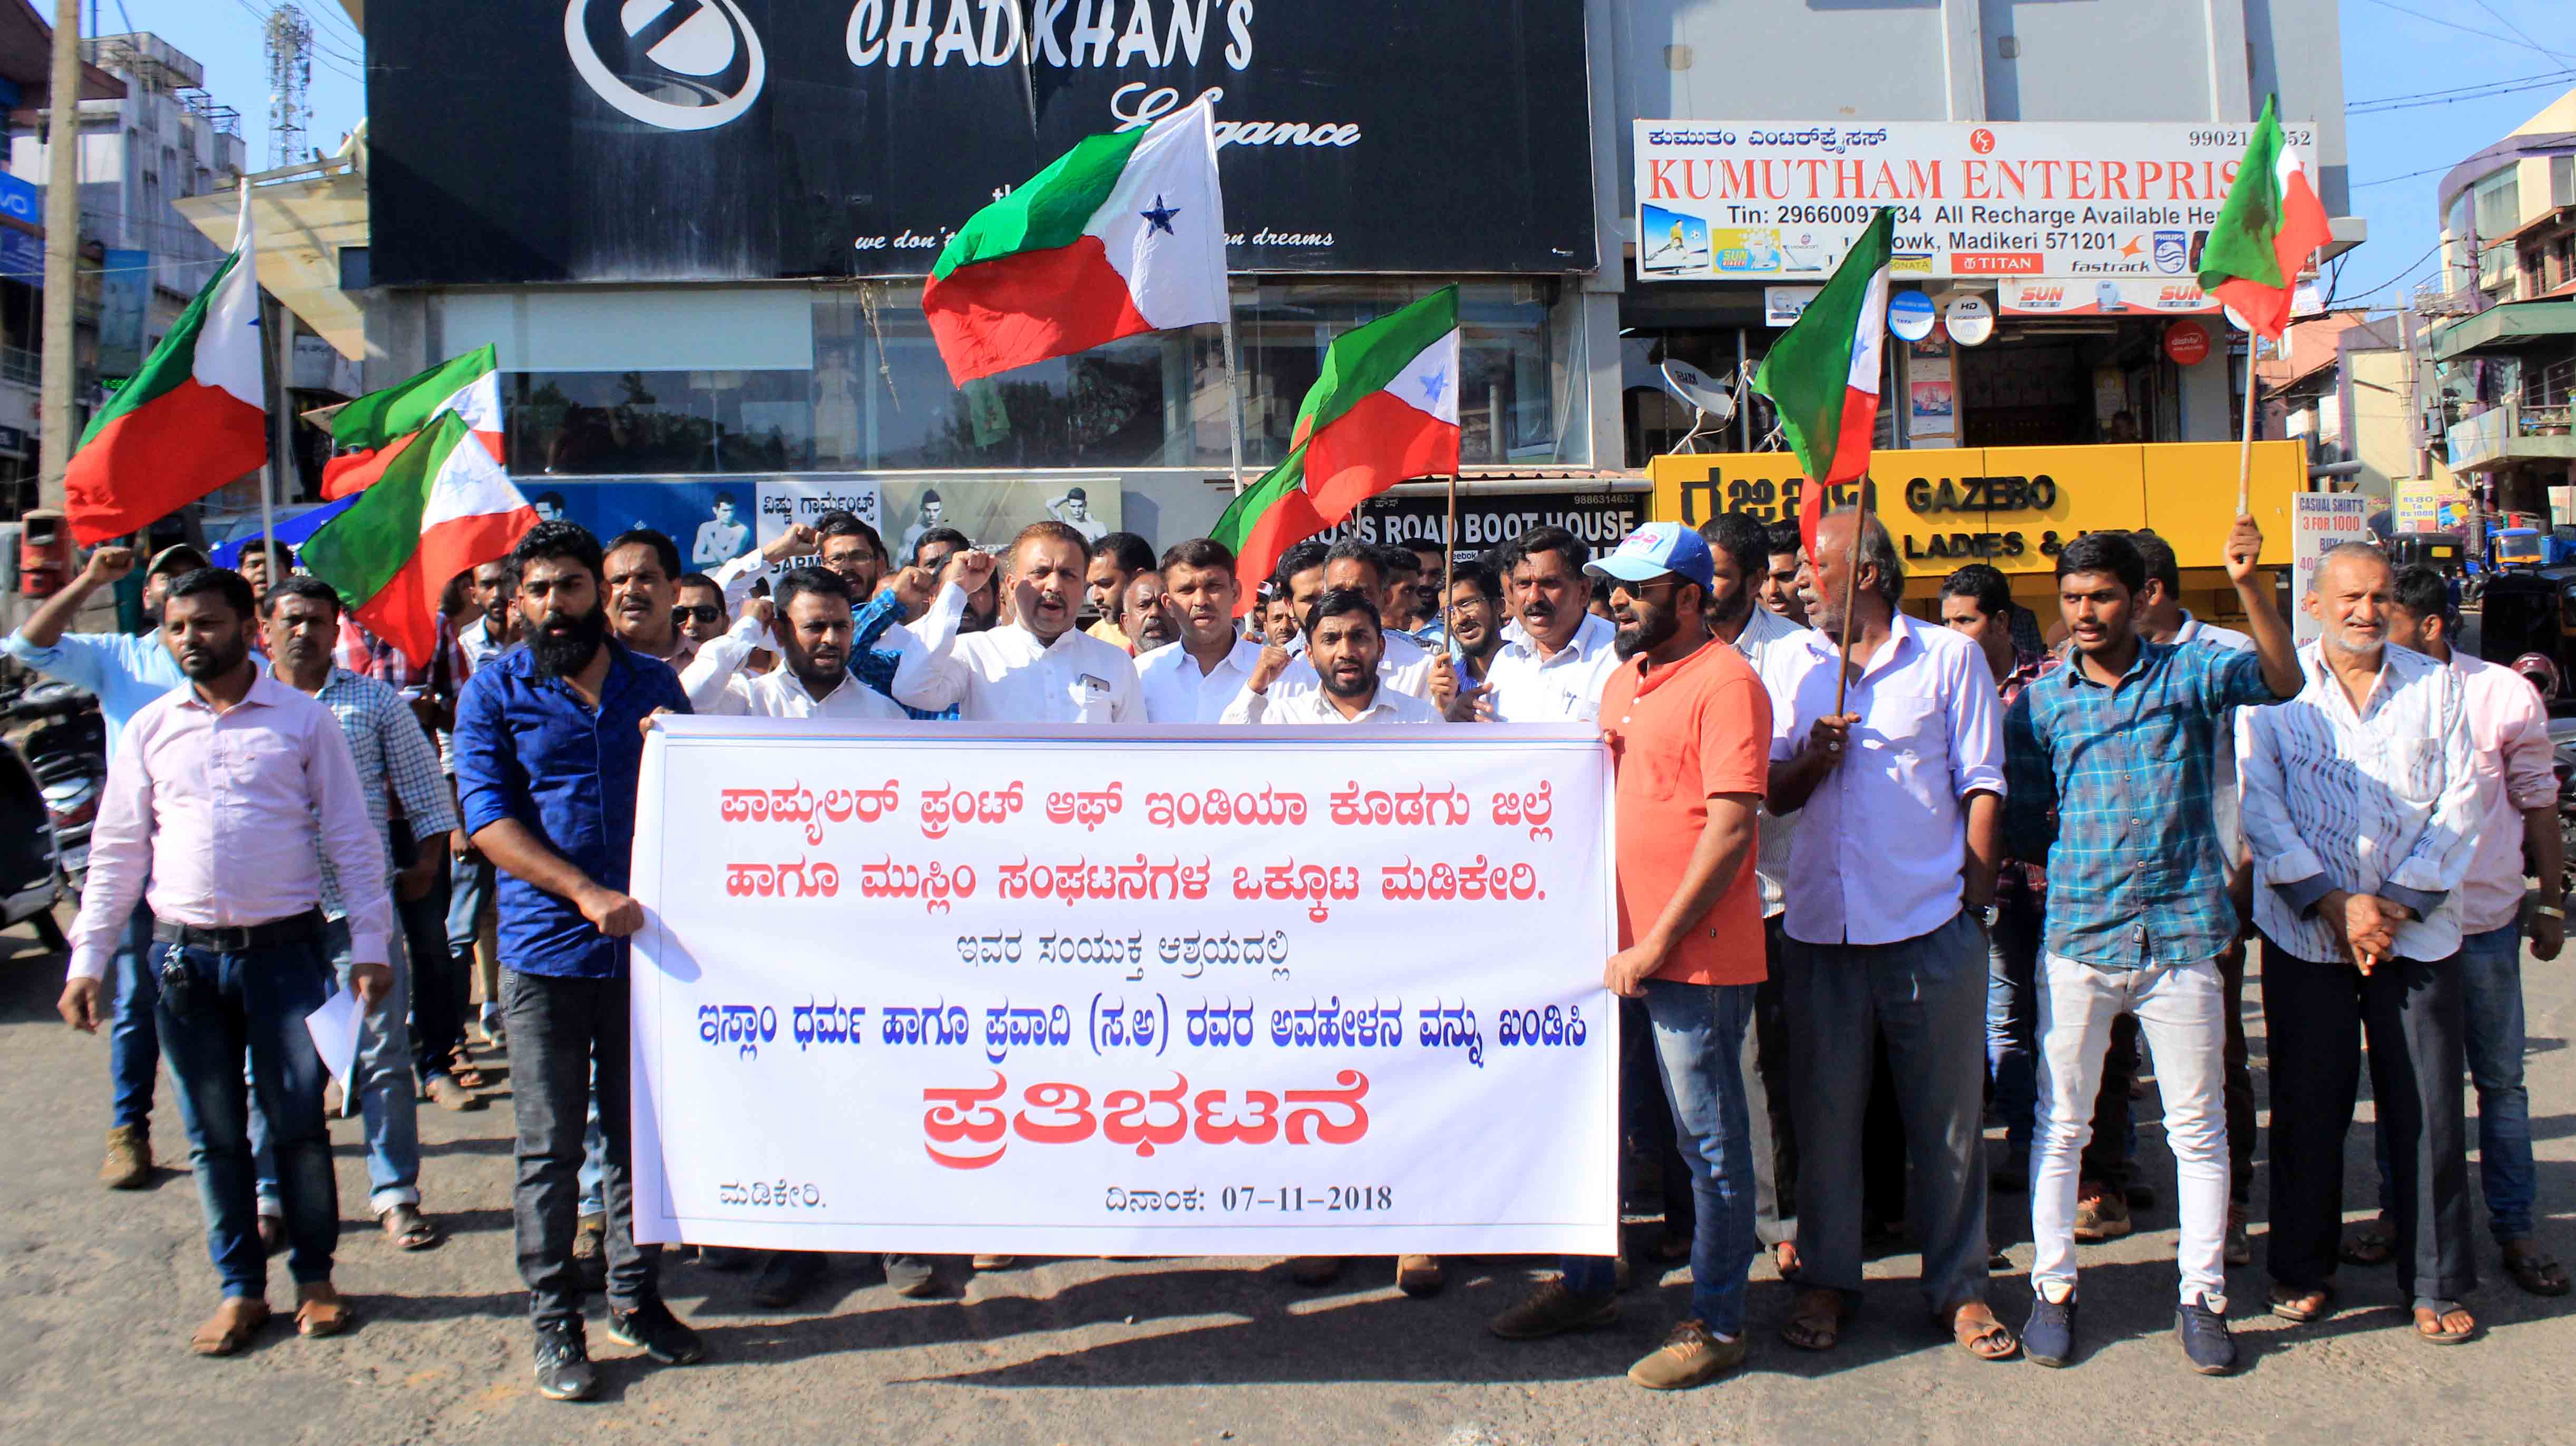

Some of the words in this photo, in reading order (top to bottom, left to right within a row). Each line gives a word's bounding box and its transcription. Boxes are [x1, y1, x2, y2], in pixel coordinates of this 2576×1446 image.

[1648, 128, 1736, 146] ಕುಮುತಂ
[1648, 159, 1943, 199] KUMUTHAM
[1727, 206, 1769, 223] Tin:
[1778, 206, 1922, 224] 2966009734
[1935, 206, 1963, 223] All
[1973, 206, 2075, 228] Recharge
[2082, 206, 2180, 224] Available
[854, 235, 886, 250] we
[1251, 226, 1335, 246] dreams
[1949, 232, 2037, 250] Madikeri
[2045, 232, 2115, 250] 571201
[1978, 258, 2032, 269] TITAN
[2071, 260, 2150, 272] fastrack
[2019, 286, 2065, 301] SUN
[2159, 286, 2203, 301] SUN
[1905, 474, 2056, 512] GAZEBO
[2299, 497, 2330, 512] CASUAL
[1384, 514, 1459, 545] ROAD
[2303, 516, 2310, 530] 3
[2312, 517, 2330, 531] FOR
[2333, 515, 2360, 531] 1000
[1904, 531, 2024, 559] LADIES
[2040, 530, 2062, 555] &
[721, 778, 899, 846] ಪಾಪ್ಯುಲರ್
[921, 780, 1024, 840] ಫ್ರಂಟ್
[1046, 781, 1123, 832] ಆಫ್
[1146, 782, 1307, 828] ಇಂಡಿಯಾ
[1330, 780, 1470, 826] ಕೊಡಗು
[1492, 780, 1553, 841] ಜಿಲ್ಲೆ
[726, 853, 840, 897] ಹಾಗೂ
[861, 853, 977, 914] ಮುಸ್ಲಿಂ
[998, 853, 1211, 907] ಸಂಘಟನೆಗಳ
[1233, 855, 1359, 923] ಒಕ್ಕೂಟ
[1382, 854, 1546, 901] ಮಡಿಕೇರಿ.
[957, 930, 1022, 967] ಇವರ
[1038, 929, 1144, 982] ಸಂಯುಕ್ತ
[1158, 929, 1290, 981] ಆಶ್ರಯದಲ್ಲಿ
[698, 1004, 777, 1061] ಇಸ್ಲಾಂ
[793, 994, 866, 1051] ಧರ್ಮ
[882, 995, 969, 1046] ಹಾಗೂ
[985, 995, 1071, 1064] ಪ್ರವಾದಿ
[1186, 996, 1254, 1048] ರವರ
[1271, 995, 1402, 1048] ಅವಹೇಳನ
[1419, 996, 1484, 1069] ವನ್ನು
[1499, 1004, 1587, 1048] ಖಂಡಿಸಿ
[923, 1068, 1370, 1170] ಪ್ರತಿಭಟನೆ
[720, 1179, 827, 1208] ಮಡಿಕೇರಿ.
[1106, 1184, 1205, 1213] ದಿನಾಂಕ:
